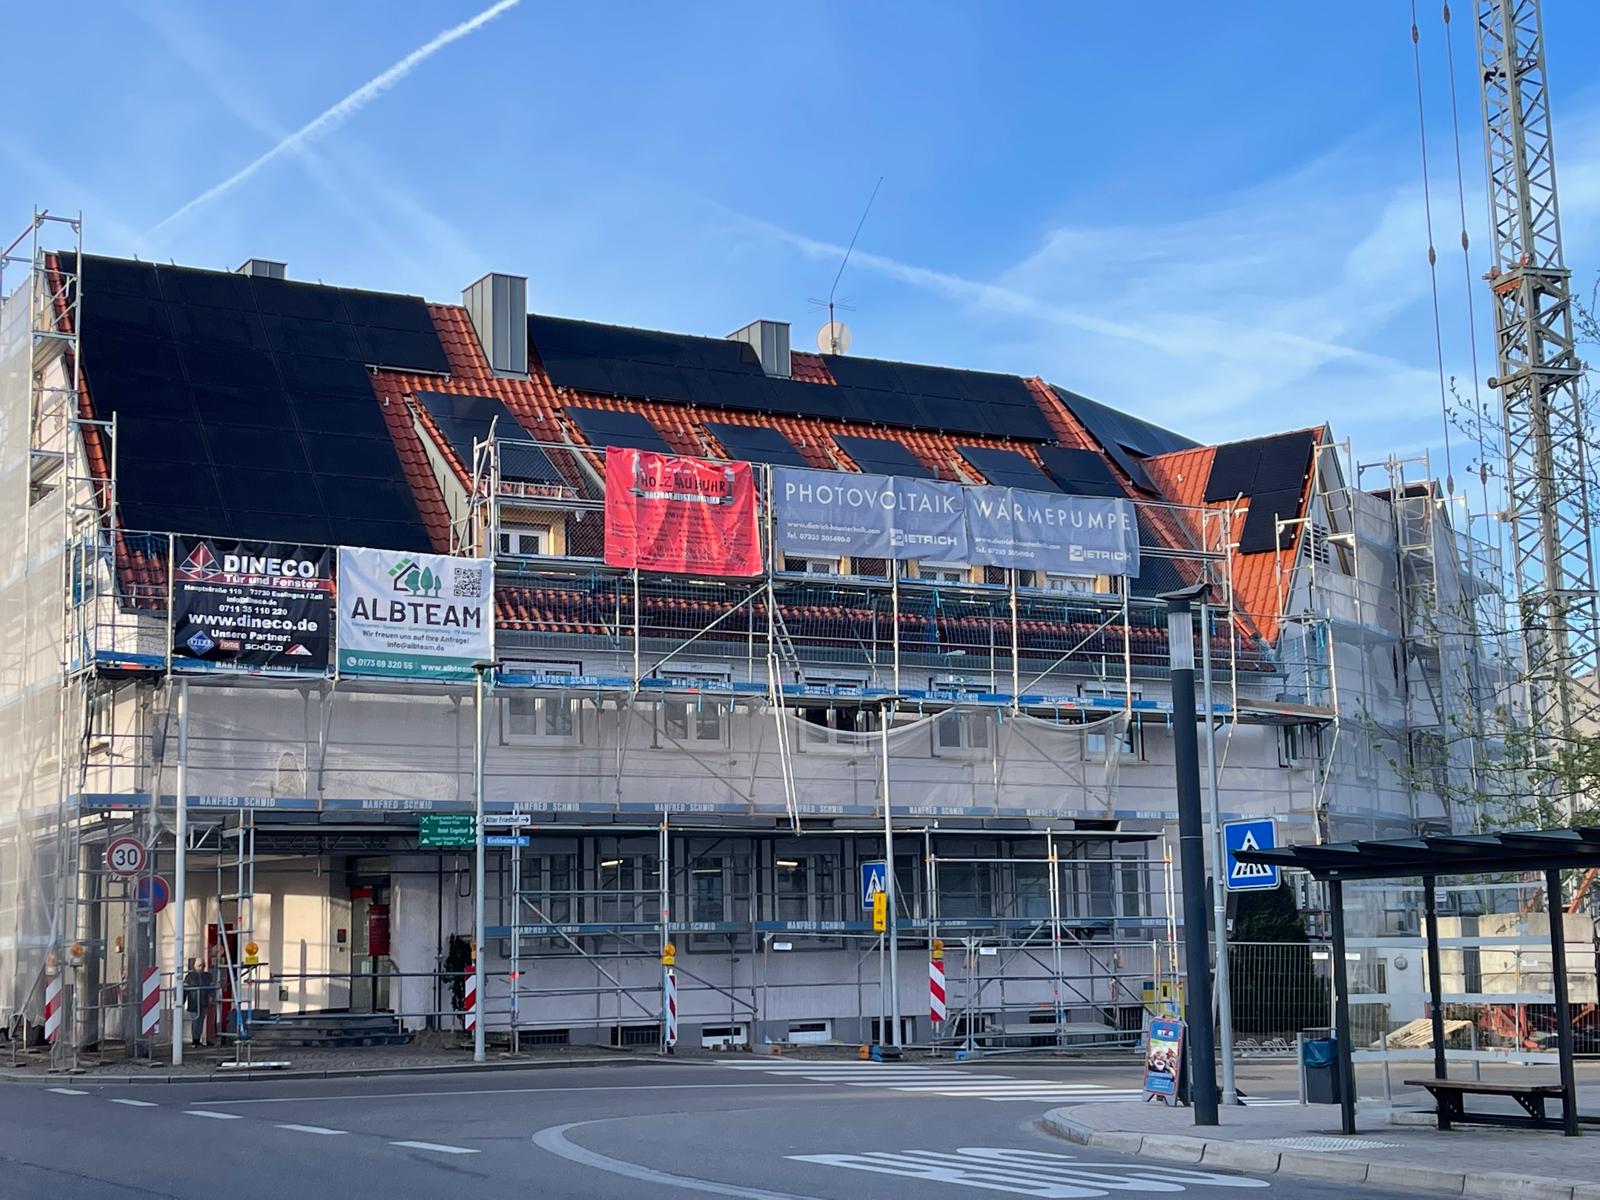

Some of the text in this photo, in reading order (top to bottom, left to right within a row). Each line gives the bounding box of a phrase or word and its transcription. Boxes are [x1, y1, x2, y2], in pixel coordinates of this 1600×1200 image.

[785, 483, 956, 514] PHOTOVOLTAIK
[973, 498, 1131, 531] WÄRMEPUMPE
[224, 574, 319, 589] Tür und Fenster
[310, 592, 324, 600] Zell
[219, 604, 240, 613] 0711
[254, 606, 270, 614] 110
[271, 607, 288, 616] 220
[351, 597, 481, 628] ALBTEAM
[188, 613, 318, 632] www.dineco.de
[211, 629, 291, 642] Unsere Partner:
[375, 631, 399, 639] freuen
[413, 633, 425, 641] auf
[440, 637, 470, 645] Anfrage!
[387, 641, 445, 652] info@albteam.de
[358, 658, 376, 667] 0173
[387, 660, 402, 669] 320
[420, 664, 474, 673] www.albteam
[199, 797, 276, 807] MANFRED SCHMID
[362, 800, 433, 809] MANFRED SCHMID
[514, 802, 580, 811] MANFRED SCHMID
[655, 803, 714, 812] MANFRED SCHMID
[115, 848, 138, 866] 30
[690, 922, 716, 931] SCHMID
[786, 921, 845, 930] MANFRED SCHMID
[783, 1147, 1270, 1198] BUS
